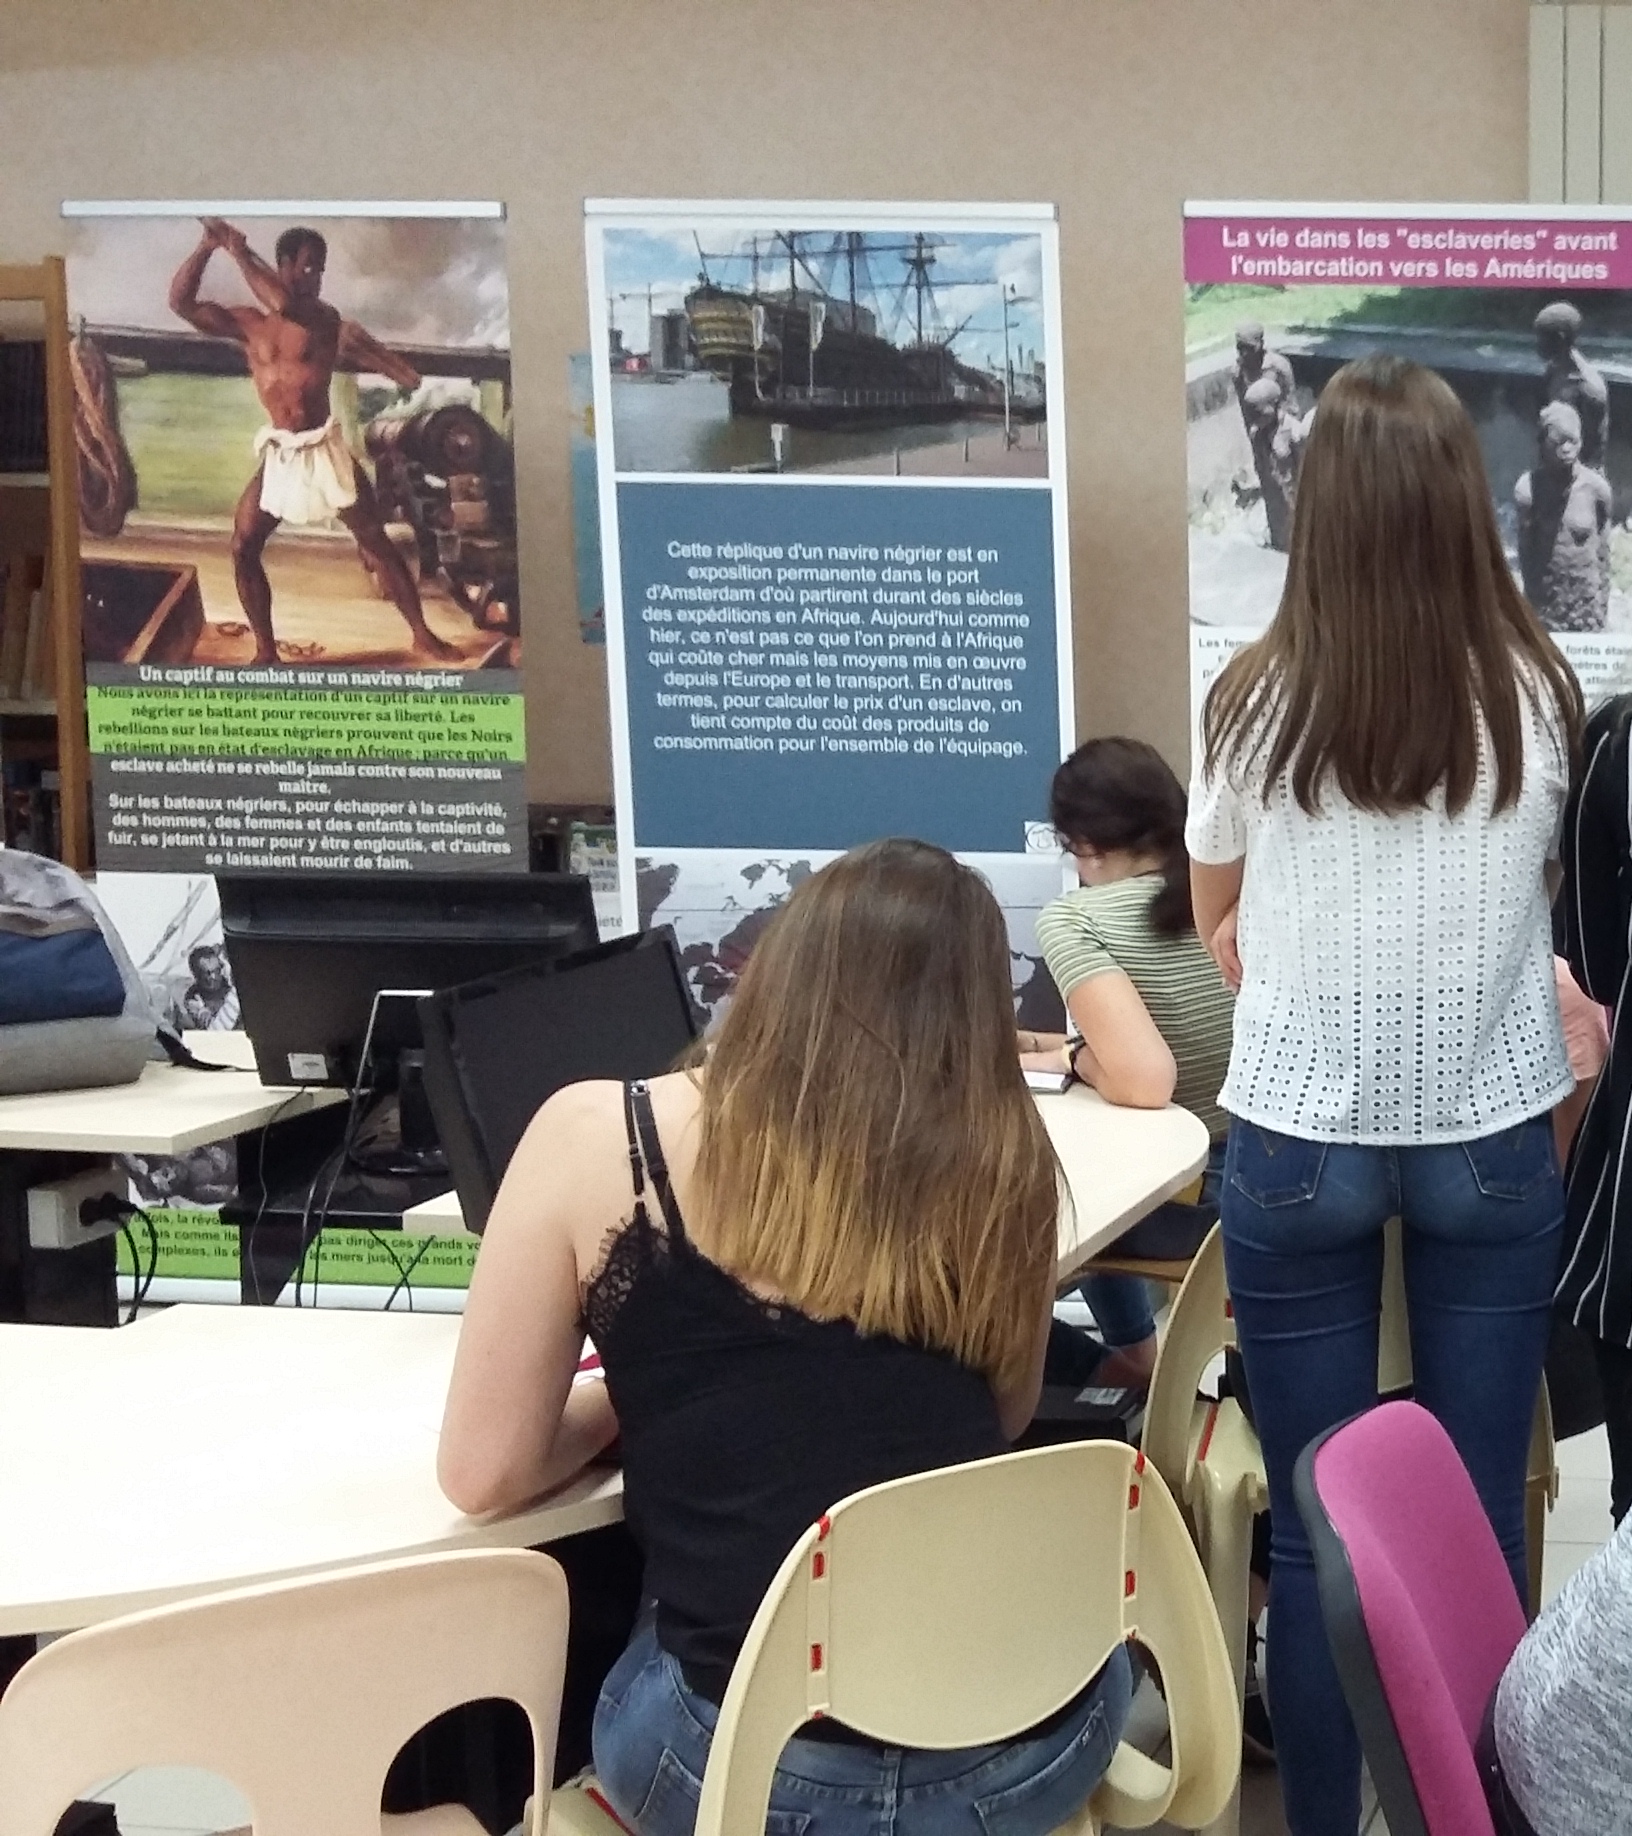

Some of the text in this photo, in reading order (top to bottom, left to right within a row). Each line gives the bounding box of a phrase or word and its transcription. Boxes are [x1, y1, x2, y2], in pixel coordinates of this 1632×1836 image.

[1223, 226, 1617, 250] La vie dans les "esclaveries" avant
[1232, 255, 1608, 283] l'embarcation vers les Amériques
[668, 541, 998, 565] Cette réplique d'un navire négrier est en
[688, 564, 979, 586] exposition permanente dans le port
[642, 606, 1029, 629] des expéditions en Afrique. Aujourd'hui comme
[140, 666, 463, 689] Un captif au combat sur un navire négrier
[664, 670, 1012, 692] depuis l'Europe et le transport. En d'autres
[132, 704, 475, 723] négrier se battant pour recouvrer sa liberté. Les
[654, 735, 1027, 757] consommation pour l'ensemble de l'équipage.
[109, 793, 506, 818] Sur les bateaux négriers, pour échapper à la captivité,
[206, 851, 412, 869] se laissaient mourir de faim.
